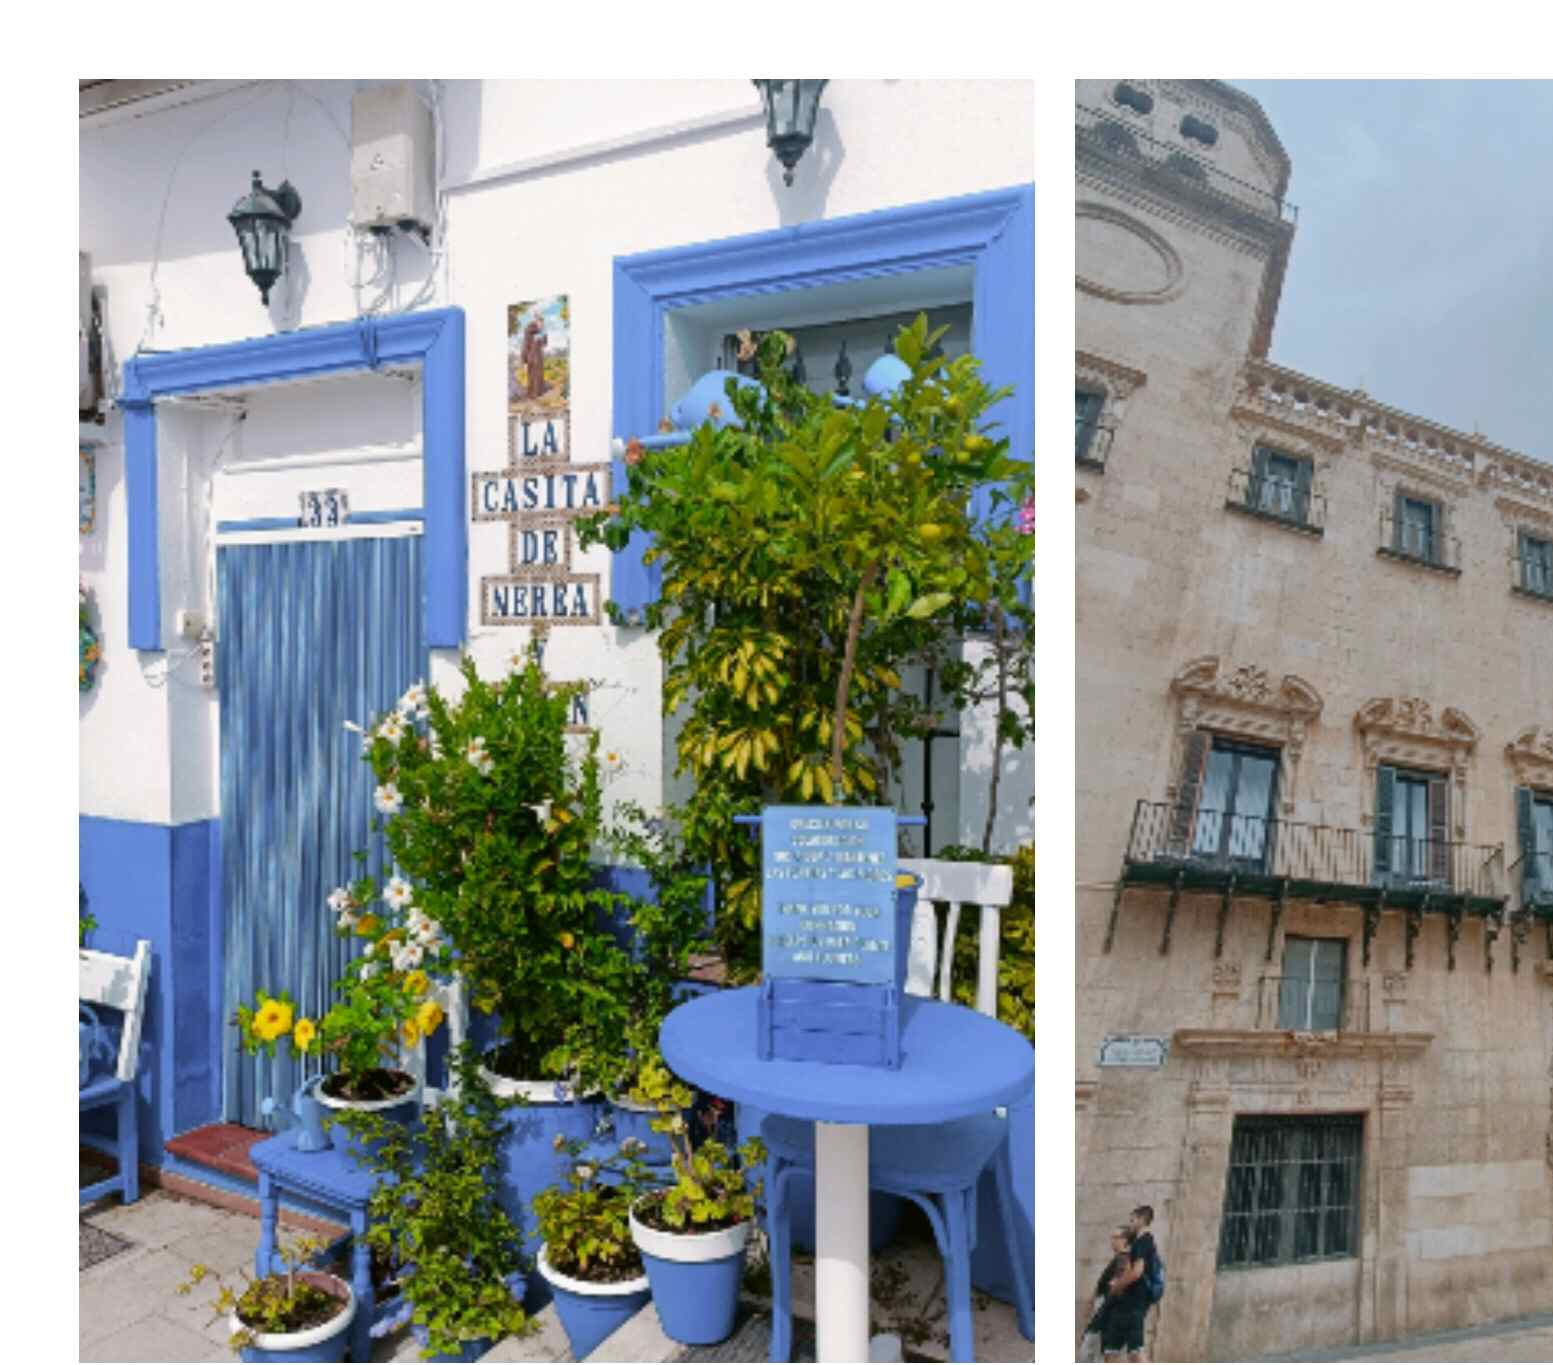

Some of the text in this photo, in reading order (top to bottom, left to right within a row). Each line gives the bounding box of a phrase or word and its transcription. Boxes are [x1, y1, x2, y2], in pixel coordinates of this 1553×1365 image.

[522, 420, 559, 457] LA
[484, 472, 600, 512] CASITA
[522, 530, 558, 564] DE
[492, 584, 588, 617] NEREA
